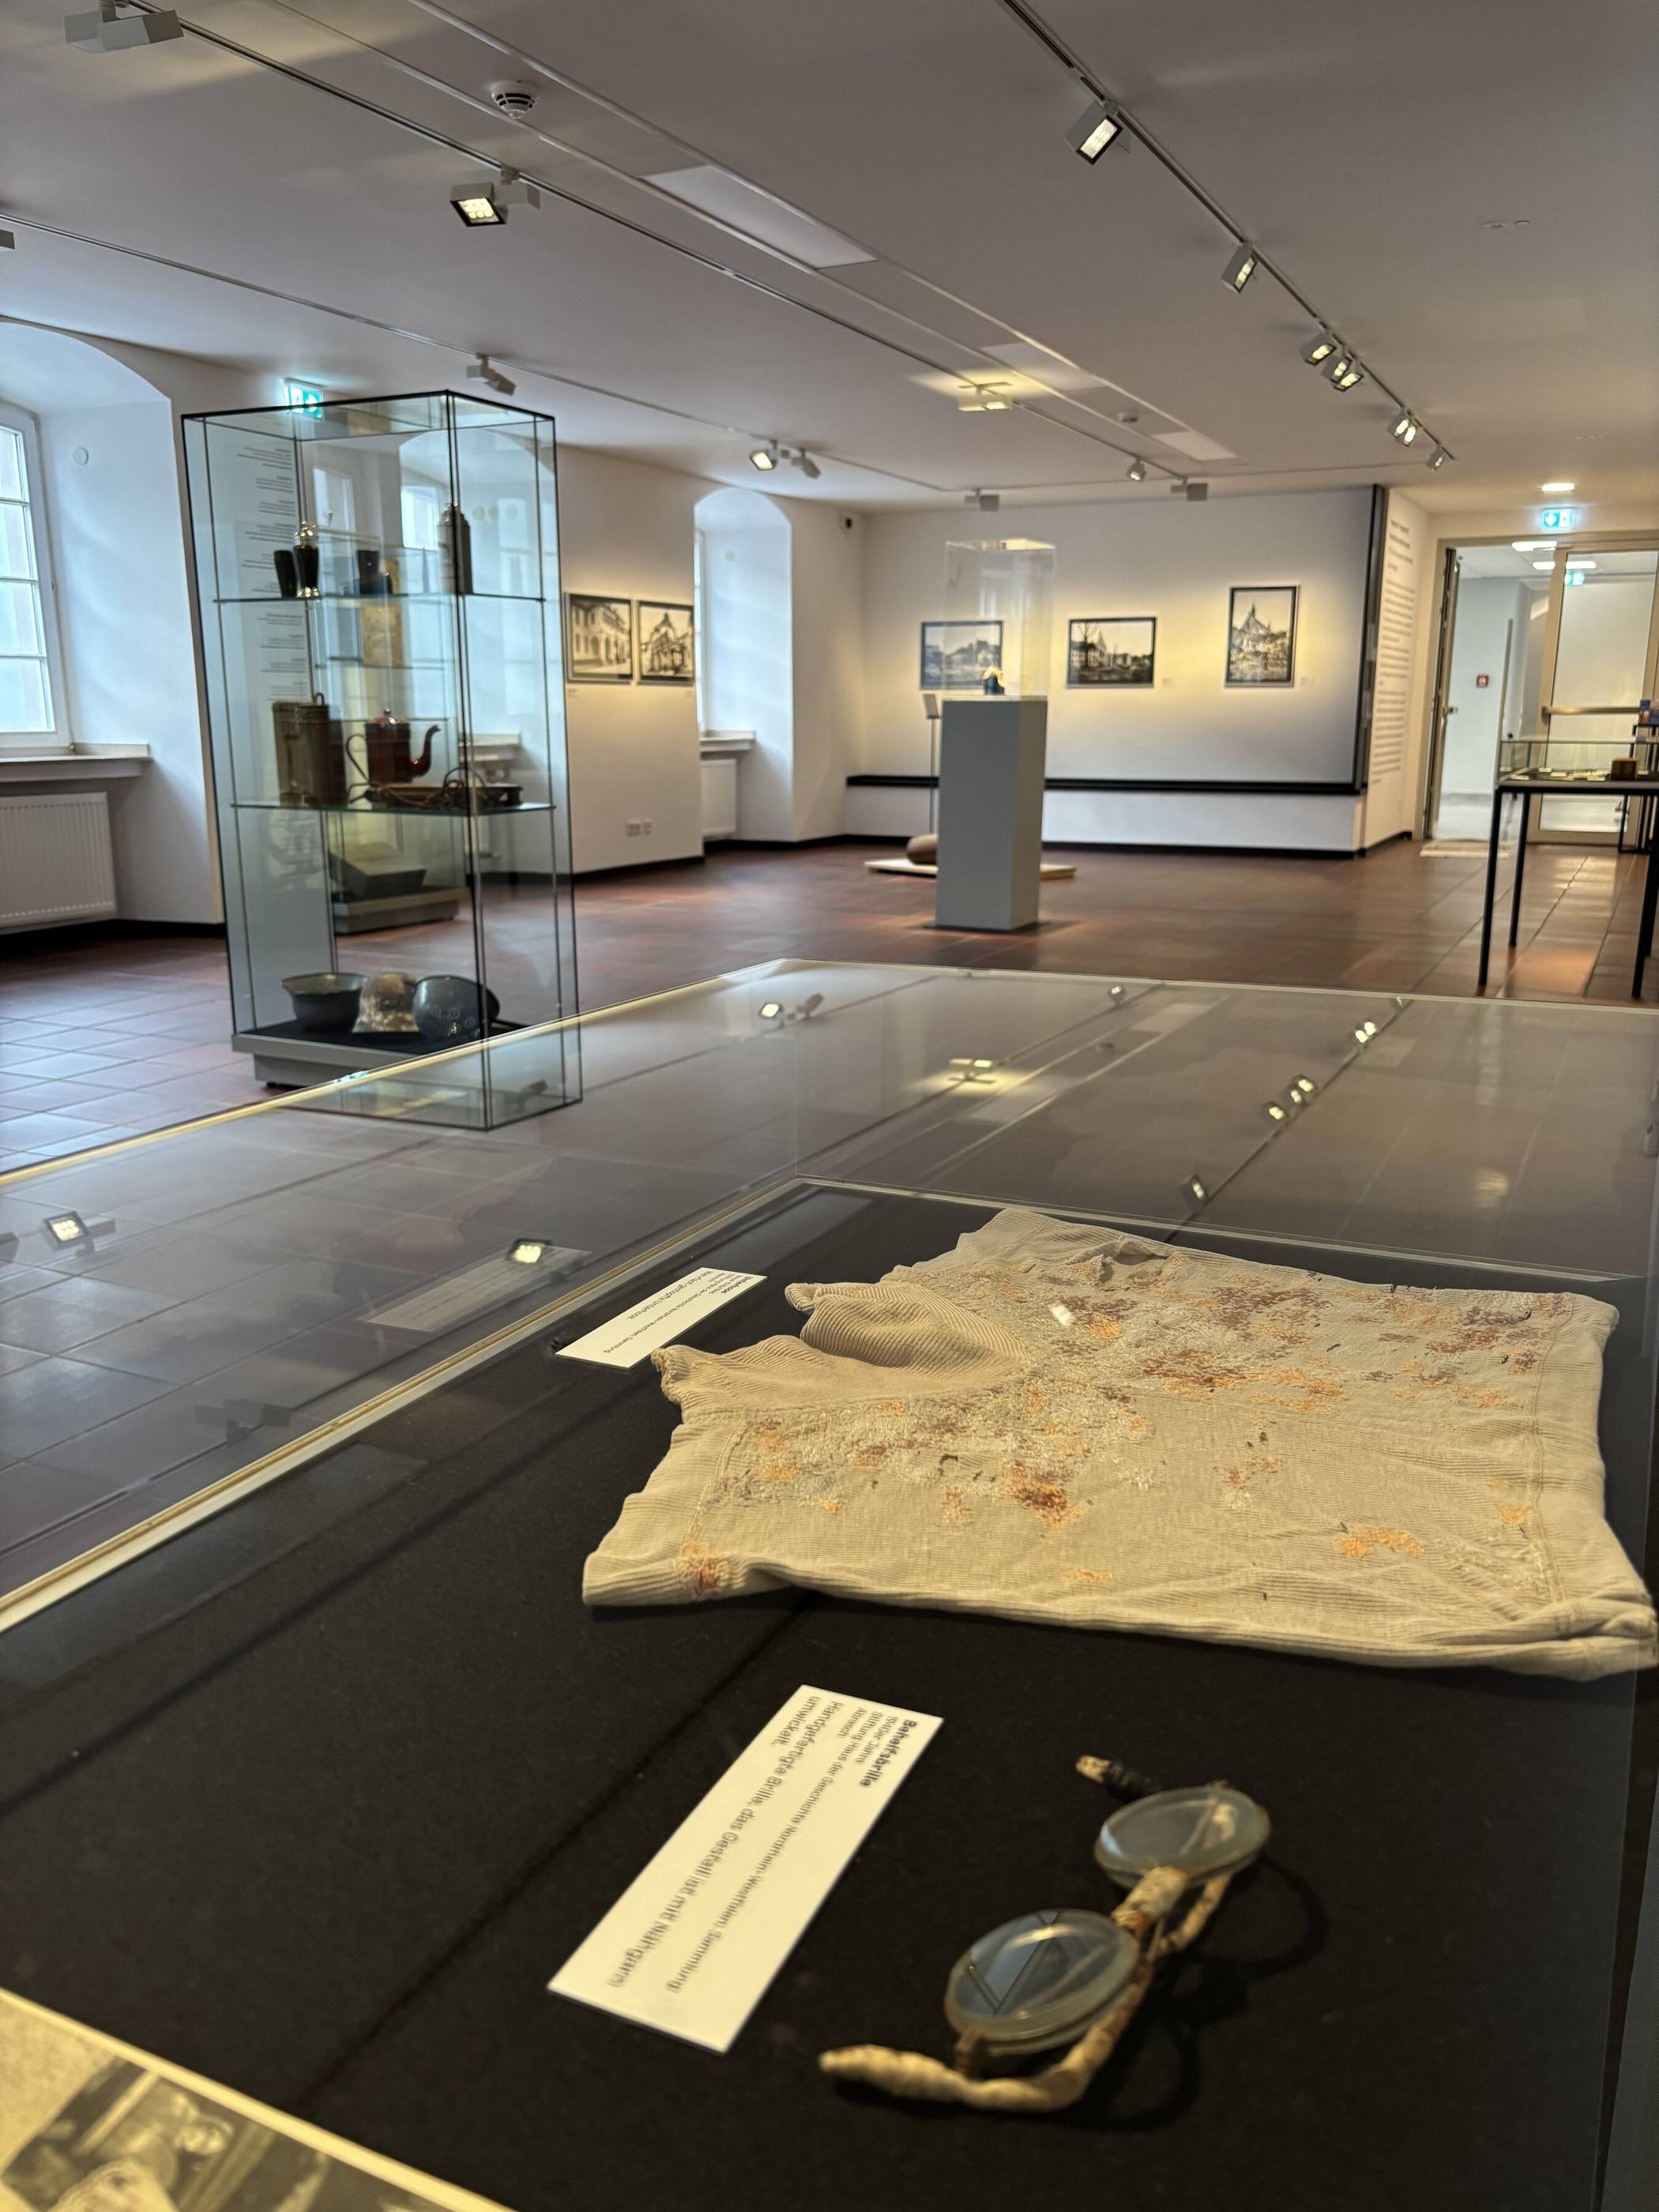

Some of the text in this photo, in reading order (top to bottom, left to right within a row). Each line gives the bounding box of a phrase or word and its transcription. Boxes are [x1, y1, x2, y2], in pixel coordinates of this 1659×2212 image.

[771, 1695, 821, 1745] umwickelt.
[773, 1701, 844, 1775] Handgefertigte
[850, 1711, 883, 1741] Stiftung
[837, 1741, 860, 1762] Haus
[855, 1716, 898, 1763] 1940er Jahre
[859, 1719, 917, 1787] Behelfsbrille
[827, 1762, 843, 1776] der
[790, 1776, 833, 1823] Geschichte
[730, 1808, 755, 1830] das
[695, 1831, 739, 1879] Gestell
[679, 1875, 705, 1896] ist
[660, 1894, 686, 1921] mit
